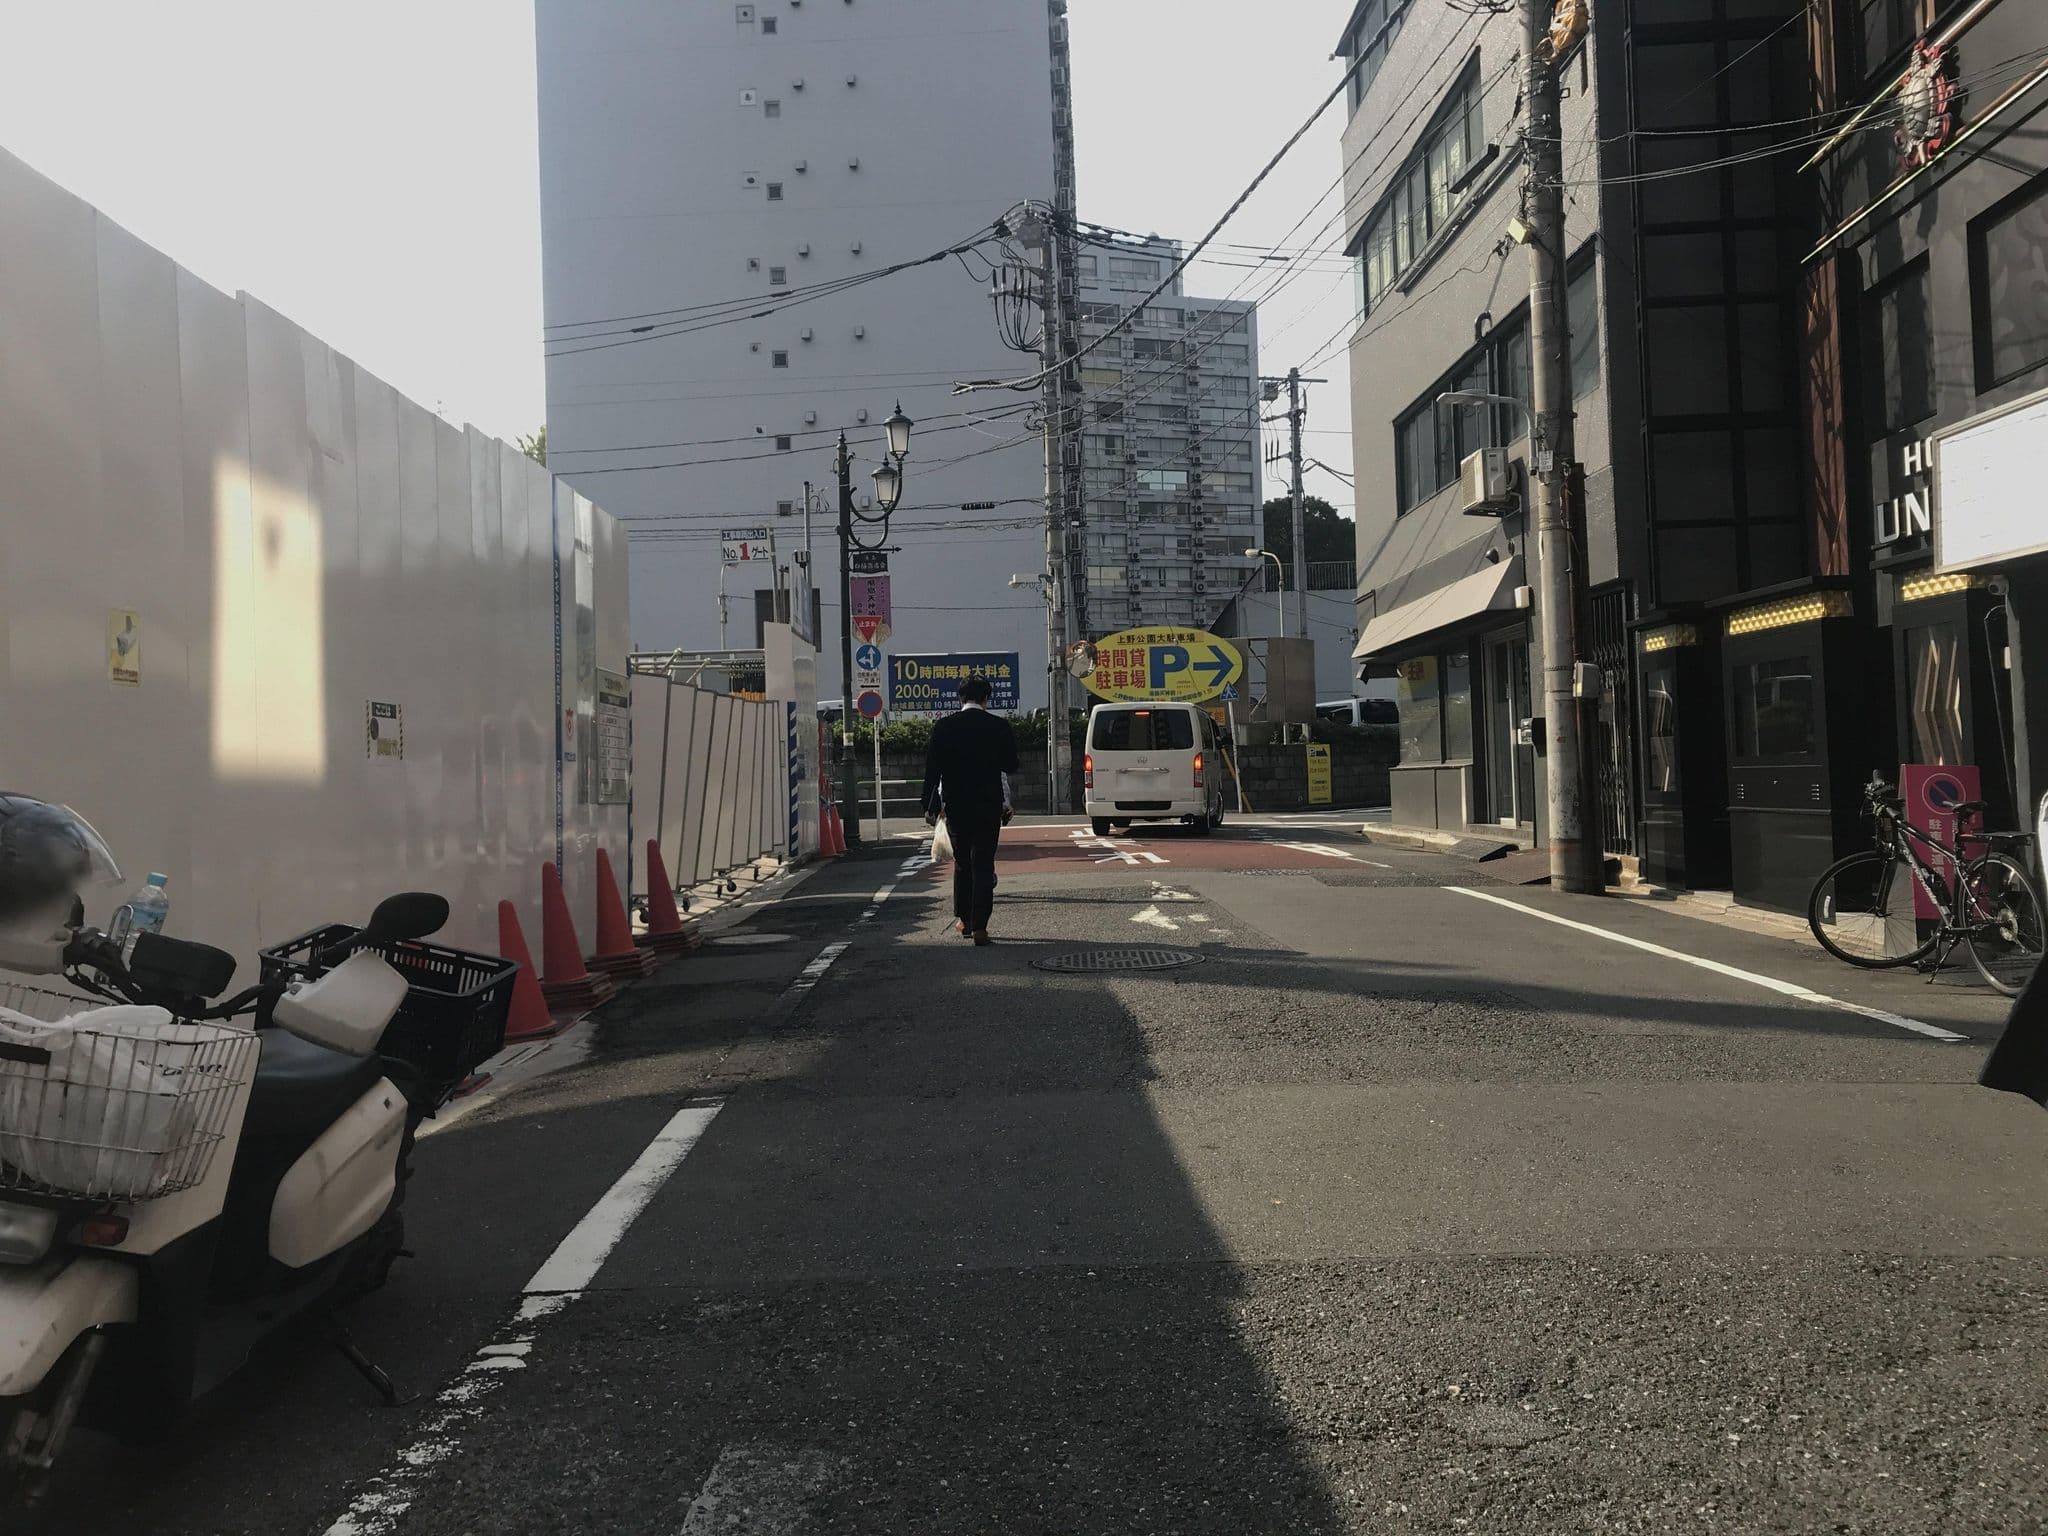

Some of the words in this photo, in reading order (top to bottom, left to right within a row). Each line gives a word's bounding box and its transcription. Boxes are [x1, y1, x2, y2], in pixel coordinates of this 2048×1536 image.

[723, 546, 738, 559] No.
[739, 542, 750, 560] 1
[752, 546, 769, 558] ゲート
[1096, 648, 1145, 668] 時間貸
[1150, 645, 1190, 689] P
[895, 659, 1011, 681] 10時間毎最大料金
[1096, 669, 1146, 690] 駐車場
[895, 684, 940, 699] 2000円
